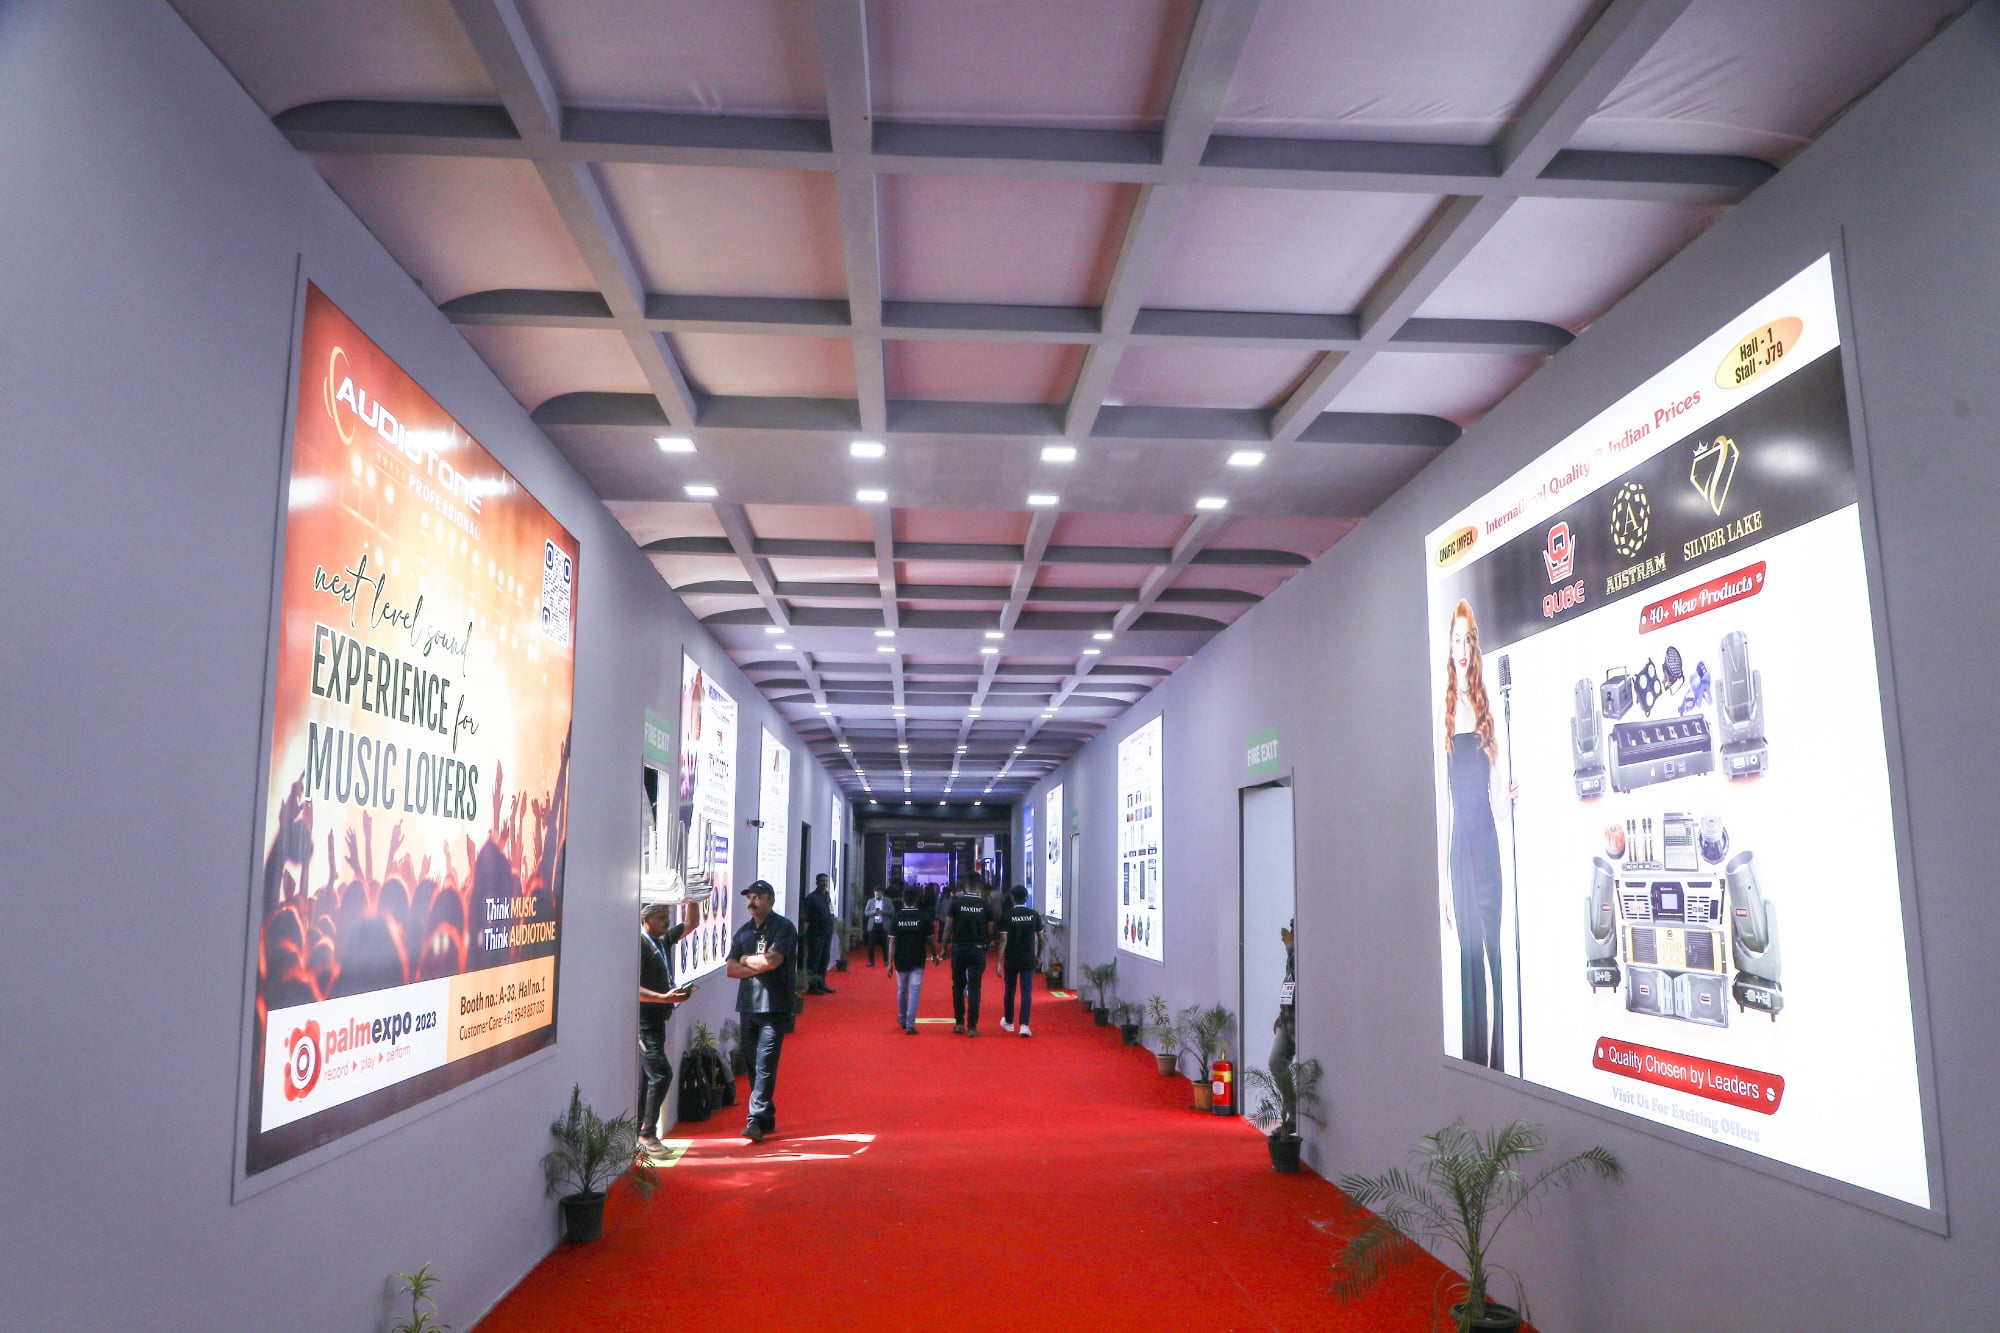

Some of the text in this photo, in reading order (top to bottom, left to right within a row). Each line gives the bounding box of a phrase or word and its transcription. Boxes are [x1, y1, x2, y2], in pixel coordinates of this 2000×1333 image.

[1735, 358, 1756, 383] Stall
[1765, 341, 1784, 365] J79
[1740, 336, 1758, 361] Hall
[1767, 327, 1773, 343] 1
[1485, 390, 1702, 535] Internatinal Quality Indian Prices
[409, 474, 480, 541] PROFESSIONAL
[1456, 529, 1474, 552] IMPEX
[1683, 510, 1763, 561] SILVER LAKE
[1606, 552, 1668, 595] AUSTRAM
[314, 555, 473, 677] next level sound
[1542, 579, 1585, 619] QUBE
[1650, 575, 1753, 625] 40+ New Products
[311, 624, 479, 753] EXPERIENCE for
[645, 721, 670, 752] FIRE EXIT
[1247, 739, 1278, 767] FIRE EXIT
[305, 722, 479, 822] MUSIC LOVERS
[486, 896, 537, 920] Think MUSIC
[484, 921, 556, 951] Think AUDIOTONE
[460, 991, 484, 1016] Booth
[518, 978, 532, 999] Hall
[325, 1011, 437, 1064] palmexpo 2023
[460, 1021, 489, 1041] Customer
[324, 1045, 411, 1081] record play perform
[1608, 1045, 1760, 1100] Quality Chosen by Leaders
[1611, 1086, 1761, 1144] Visit Us For Exciting Offers
